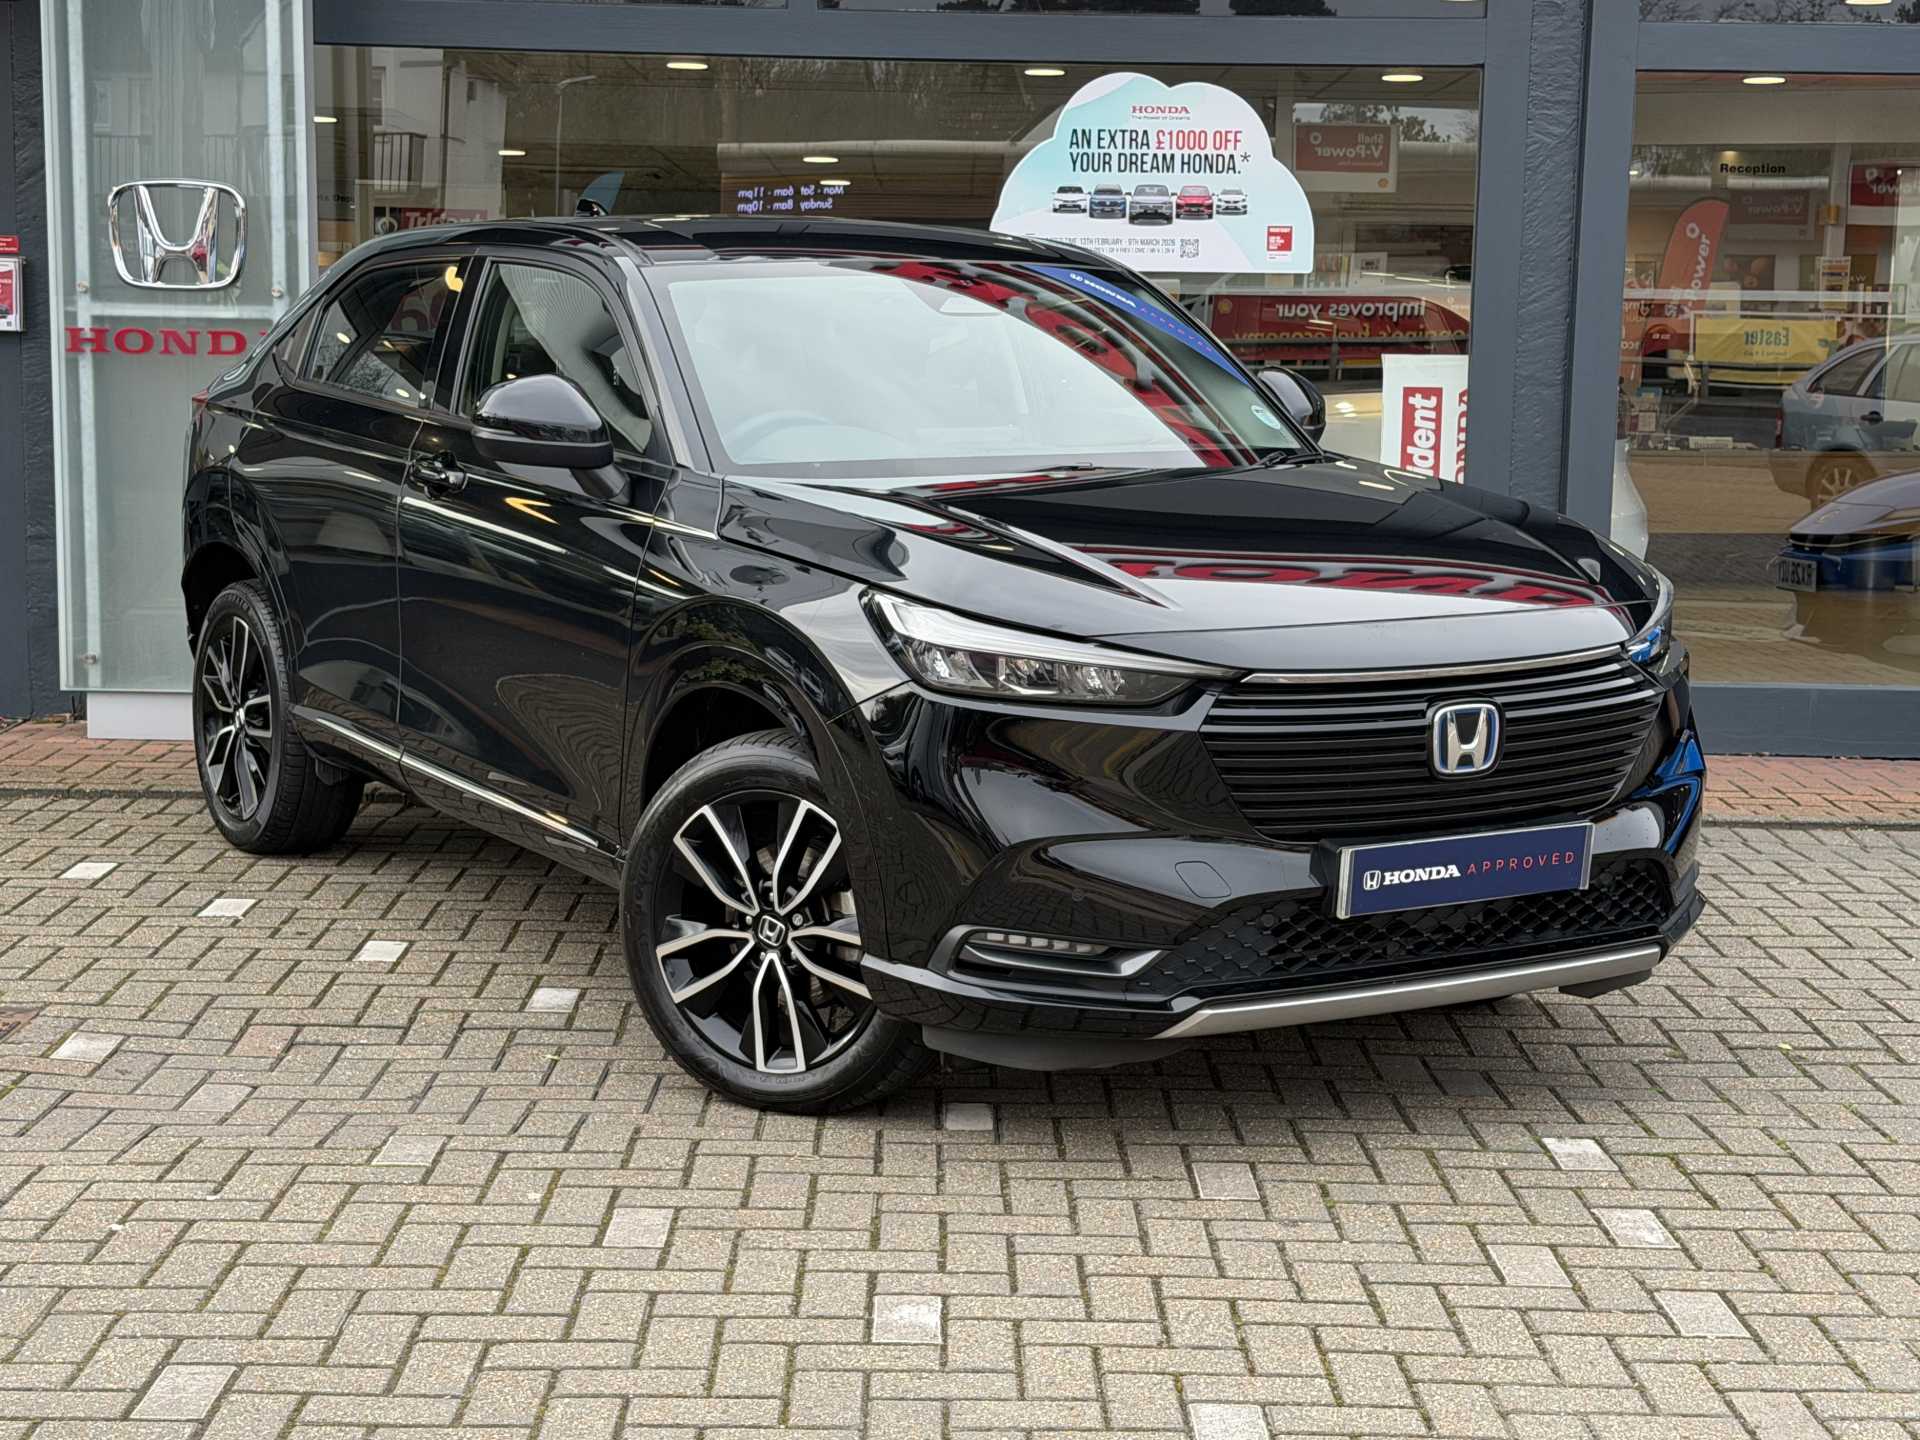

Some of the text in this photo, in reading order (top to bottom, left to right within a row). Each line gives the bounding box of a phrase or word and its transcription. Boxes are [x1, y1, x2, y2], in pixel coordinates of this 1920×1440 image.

[1131, 105, 1190, 115] HONDA
[1069, 128, 1243, 151] AN EXTRA £1000 OFF
[1070, 152, 1112, 173] YOUR
[1117, 153, 1175, 174] DREAM
[1719, 163, 1786, 176] Reception
[64, 326, 268, 356] HOND
[1406, 392, 1437, 477] ident
[1383, 850, 1576, 886] HONDA APPROVED
